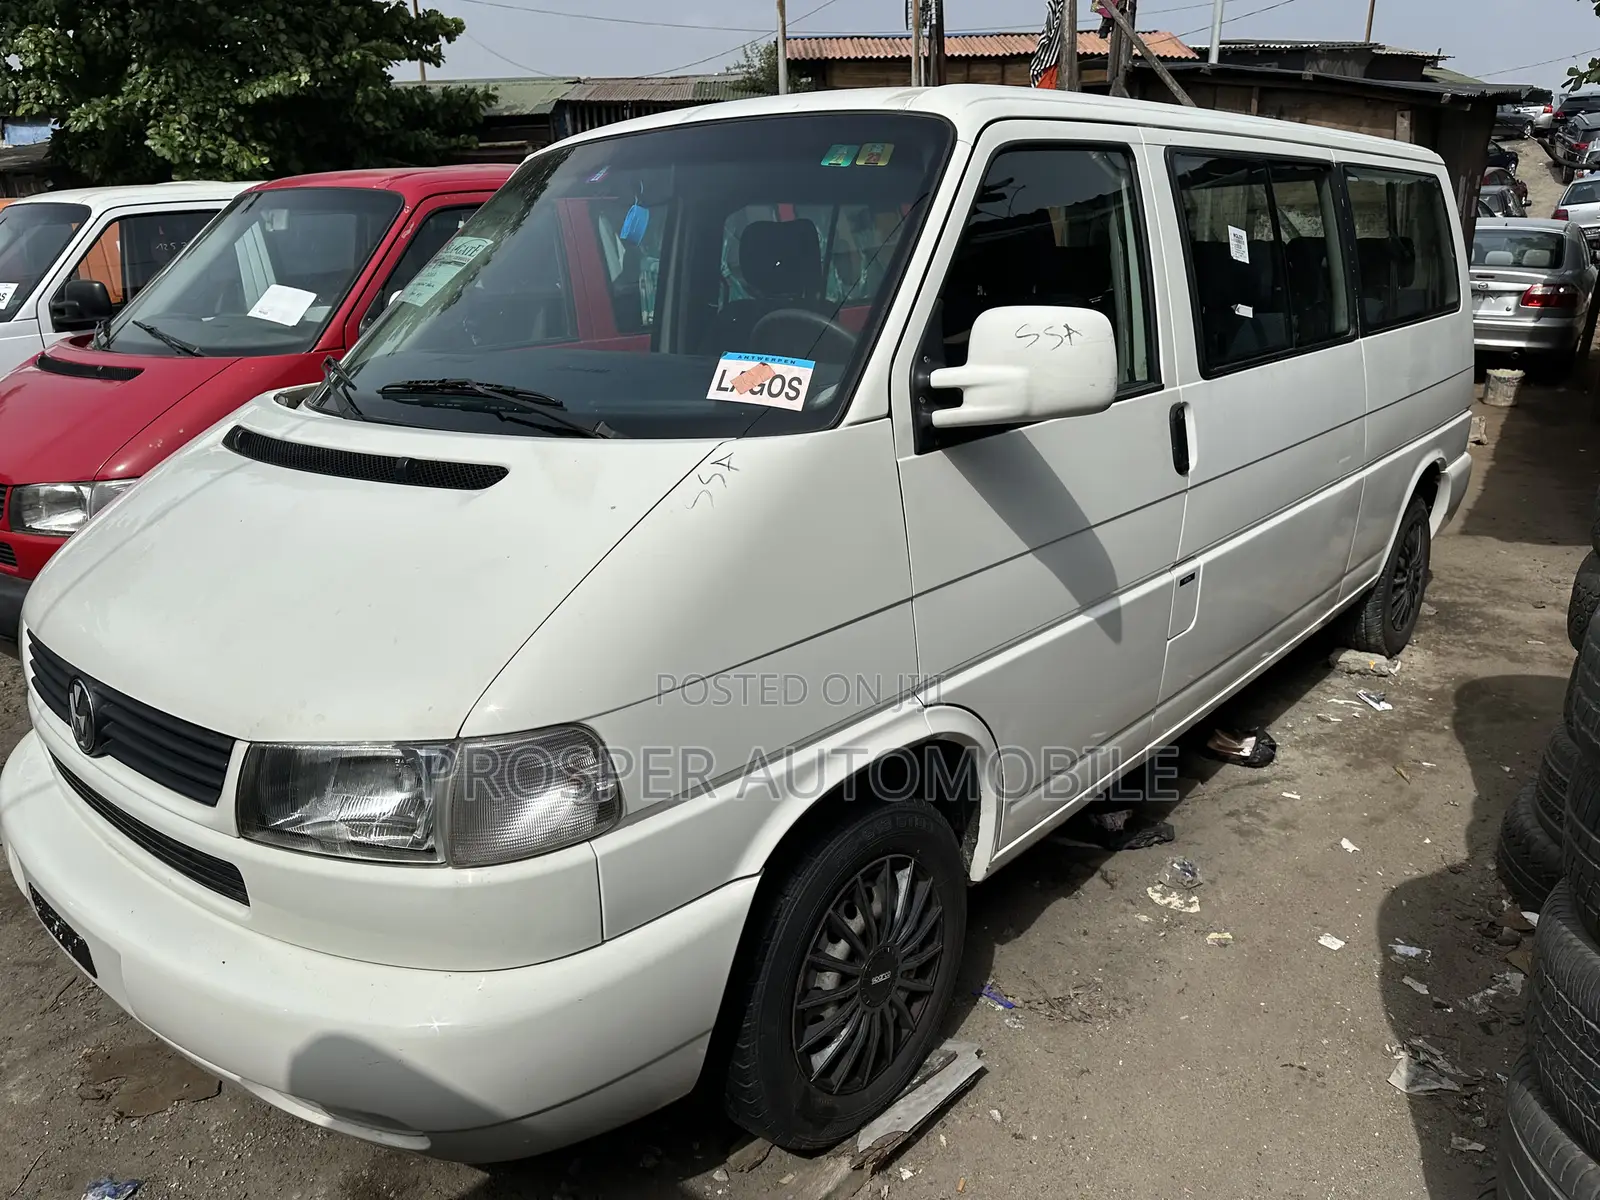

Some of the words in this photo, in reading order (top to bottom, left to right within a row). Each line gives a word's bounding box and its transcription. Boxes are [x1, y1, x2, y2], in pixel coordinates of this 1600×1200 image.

[1014, 322, 1083, 352] SSA
[737, 354, 796, 365] ANTWERPEN
[715, 369, 803, 401] LOS
